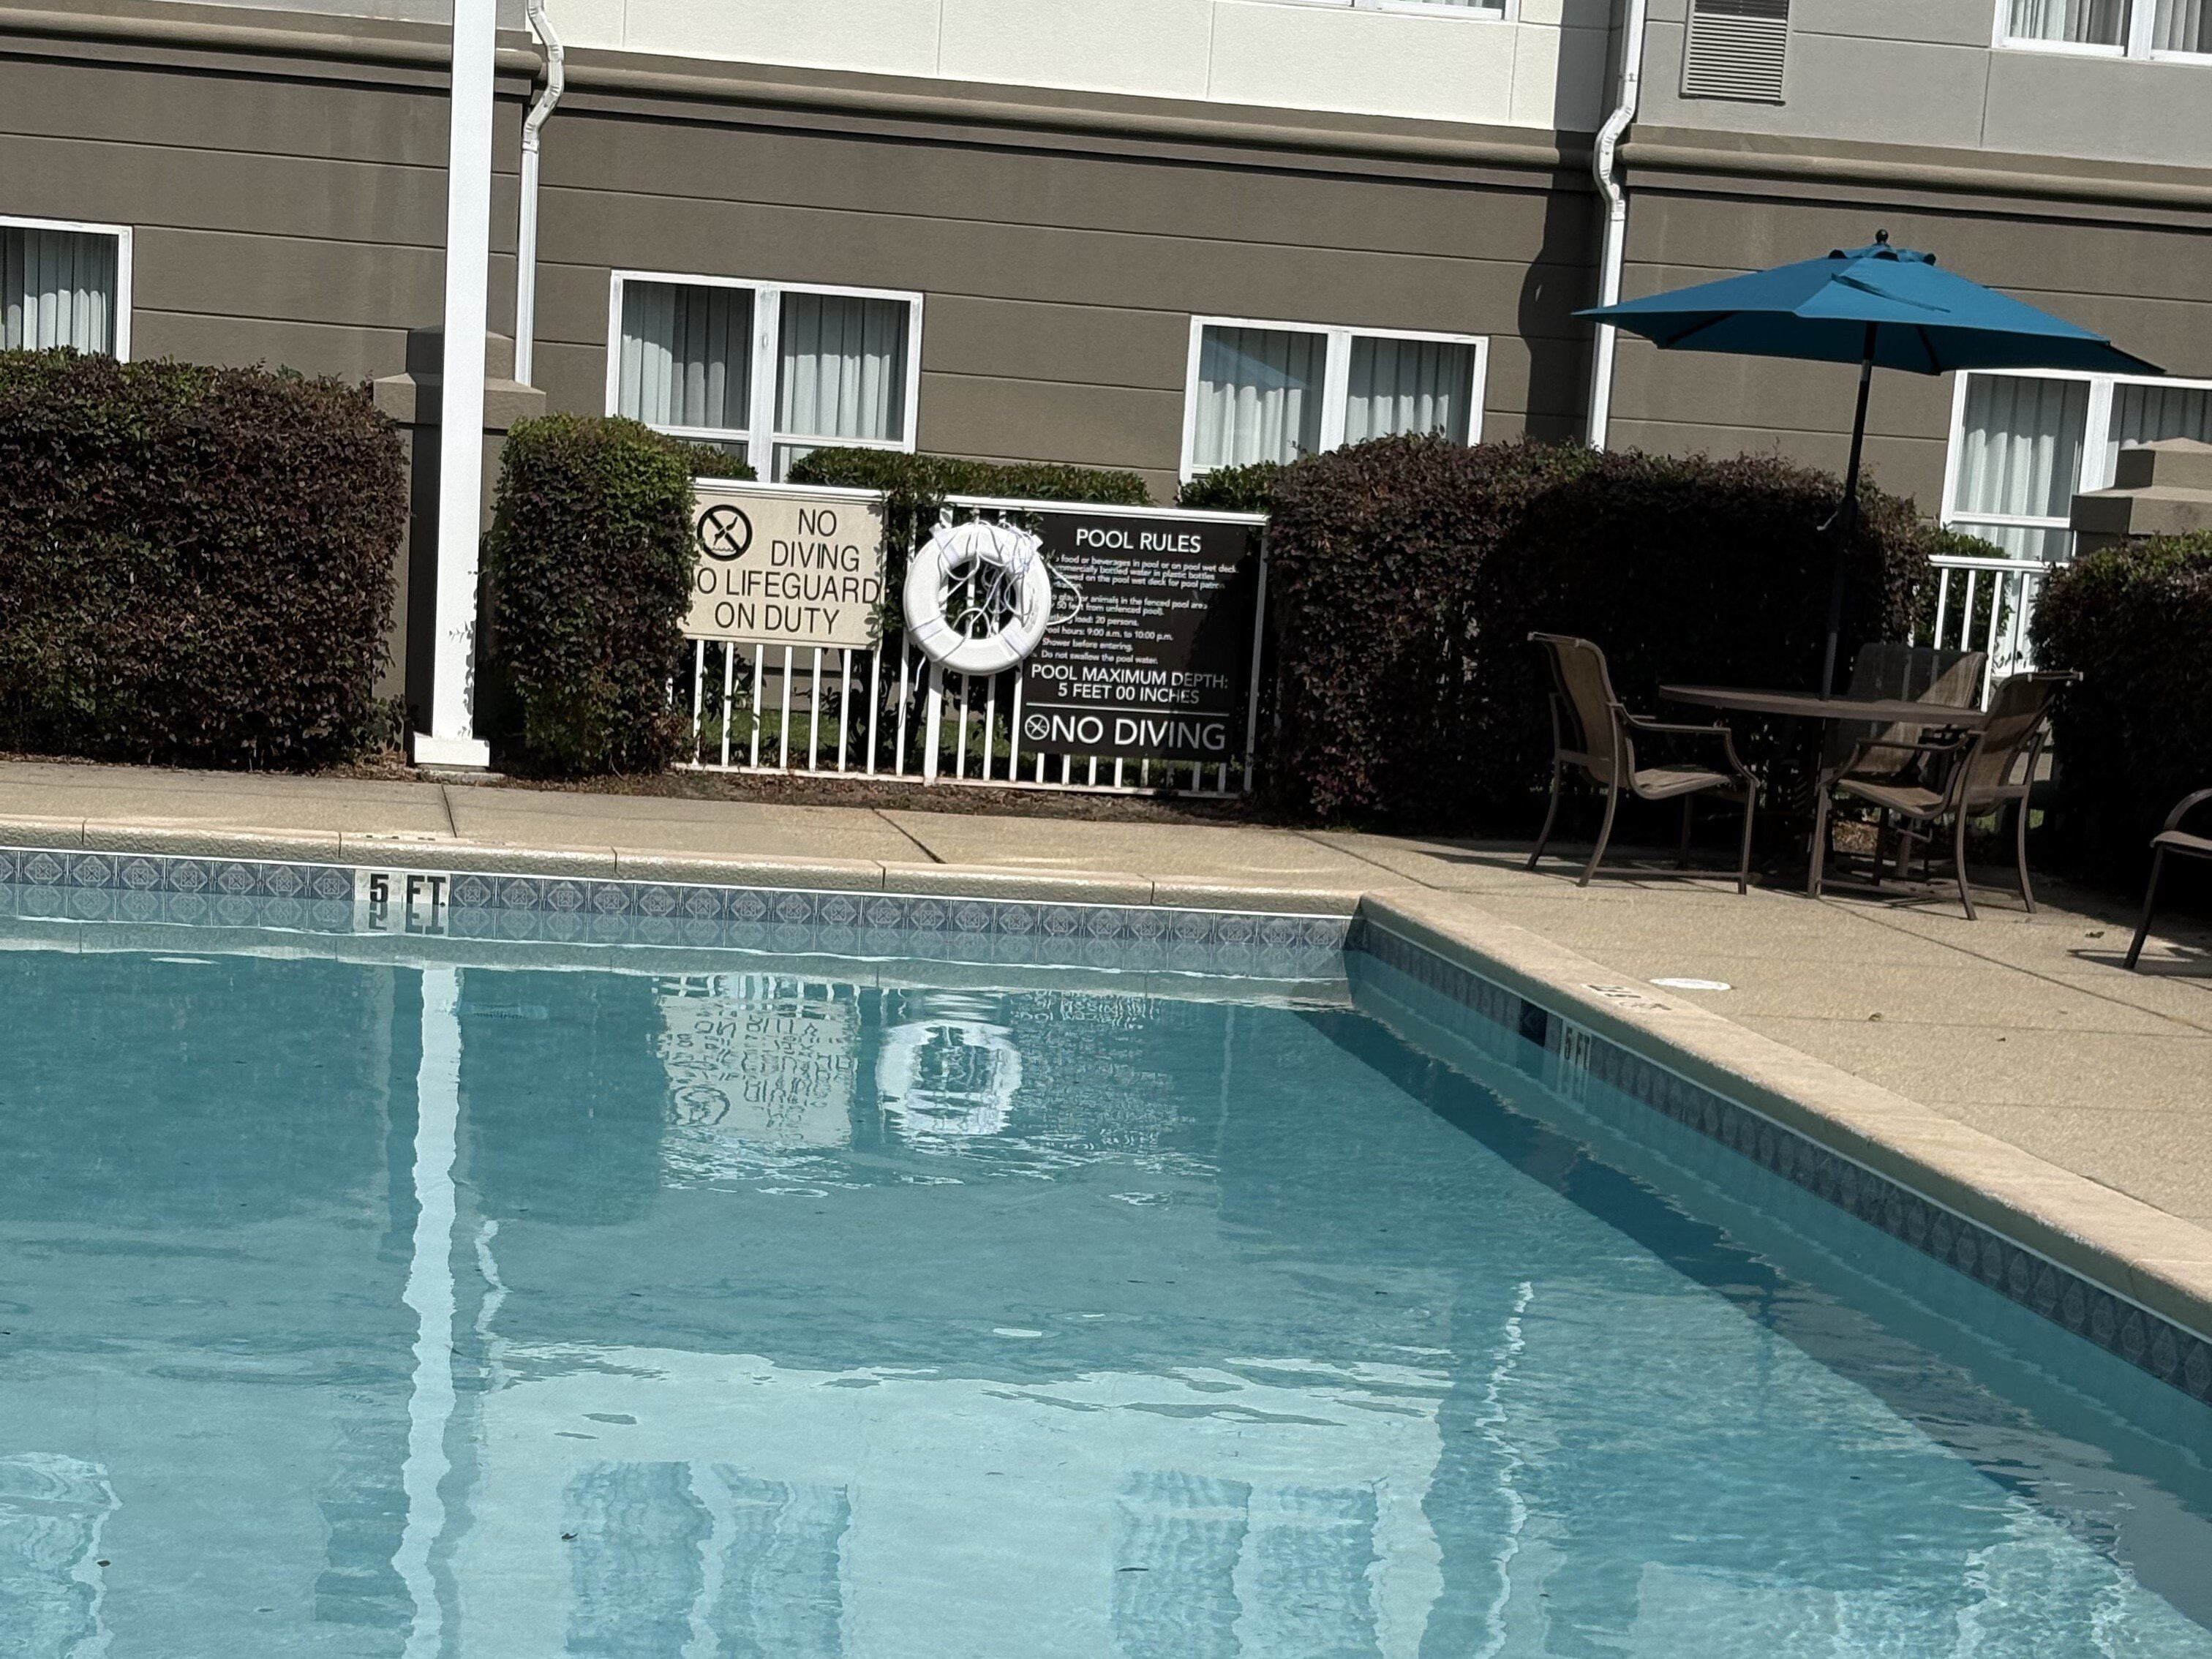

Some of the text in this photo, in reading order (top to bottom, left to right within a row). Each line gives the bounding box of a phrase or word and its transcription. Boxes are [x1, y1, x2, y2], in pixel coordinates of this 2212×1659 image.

[798, 508, 837, 537] NO
[1076, 528, 1202, 554] POOL RULES
[770, 540, 860, 572] DIVING
[1061, 554, 1080, 564] food
[1091, 556, 1131, 568] beverages
[1132, 559, 1140, 567] in
[1142, 560, 1159, 572] pool
[1183, 563, 1200, 572] pool
[1202, 564, 1217, 572] wet
[1097, 574, 1111, 582] the
[1112, 576, 1130, 585] pool
[1132, 577, 1146, 585] wet
[1181, 580, 1198, 590] pool
[1099, 565, 1129, 575] bottled
[1162, 569, 1186, 581] plastic
[1187, 571, 1215, 580] bottles
[726, 569, 879, 604] LIFEGUARD
[1056, 601, 1067, 610] 50
[1086, 602, 1105, 612] from
[1106, 604, 1141, 614] unfenced
[1091, 595, 1118, 604] animals
[1121, 596, 1129, 604] in
[1129, 596, 1143, 606] the
[1144, 596, 1170, 607] fenced
[1171, 600, 1189, 610] pool
[715, 601, 840, 635] ON DUTY
[1095, 615, 1106, 624] 20
[1087, 628, 1105, 636] 9:00
[1124, 631, 1133, 639] to
[1135, 631, 1156, 639] 10:00
[1072, 639, 1099, 649] before
[1041, 649, 1053, 658] Do
[1055, 651, 1068, 659] not
[1069, 651, 1100, 661] swallow
[1101, 652, 1115, 662] the
[1116, 654, 1135, 665] pool
[1031, 663, 1229, 689] POOL MAXIMUM DEPTH:
[1058, 682, 1200, 704] 5 FEET 00 INCHES
[1051, 715, 1226, 750] NO DIVING
[370, 873, 389, 903] 5
